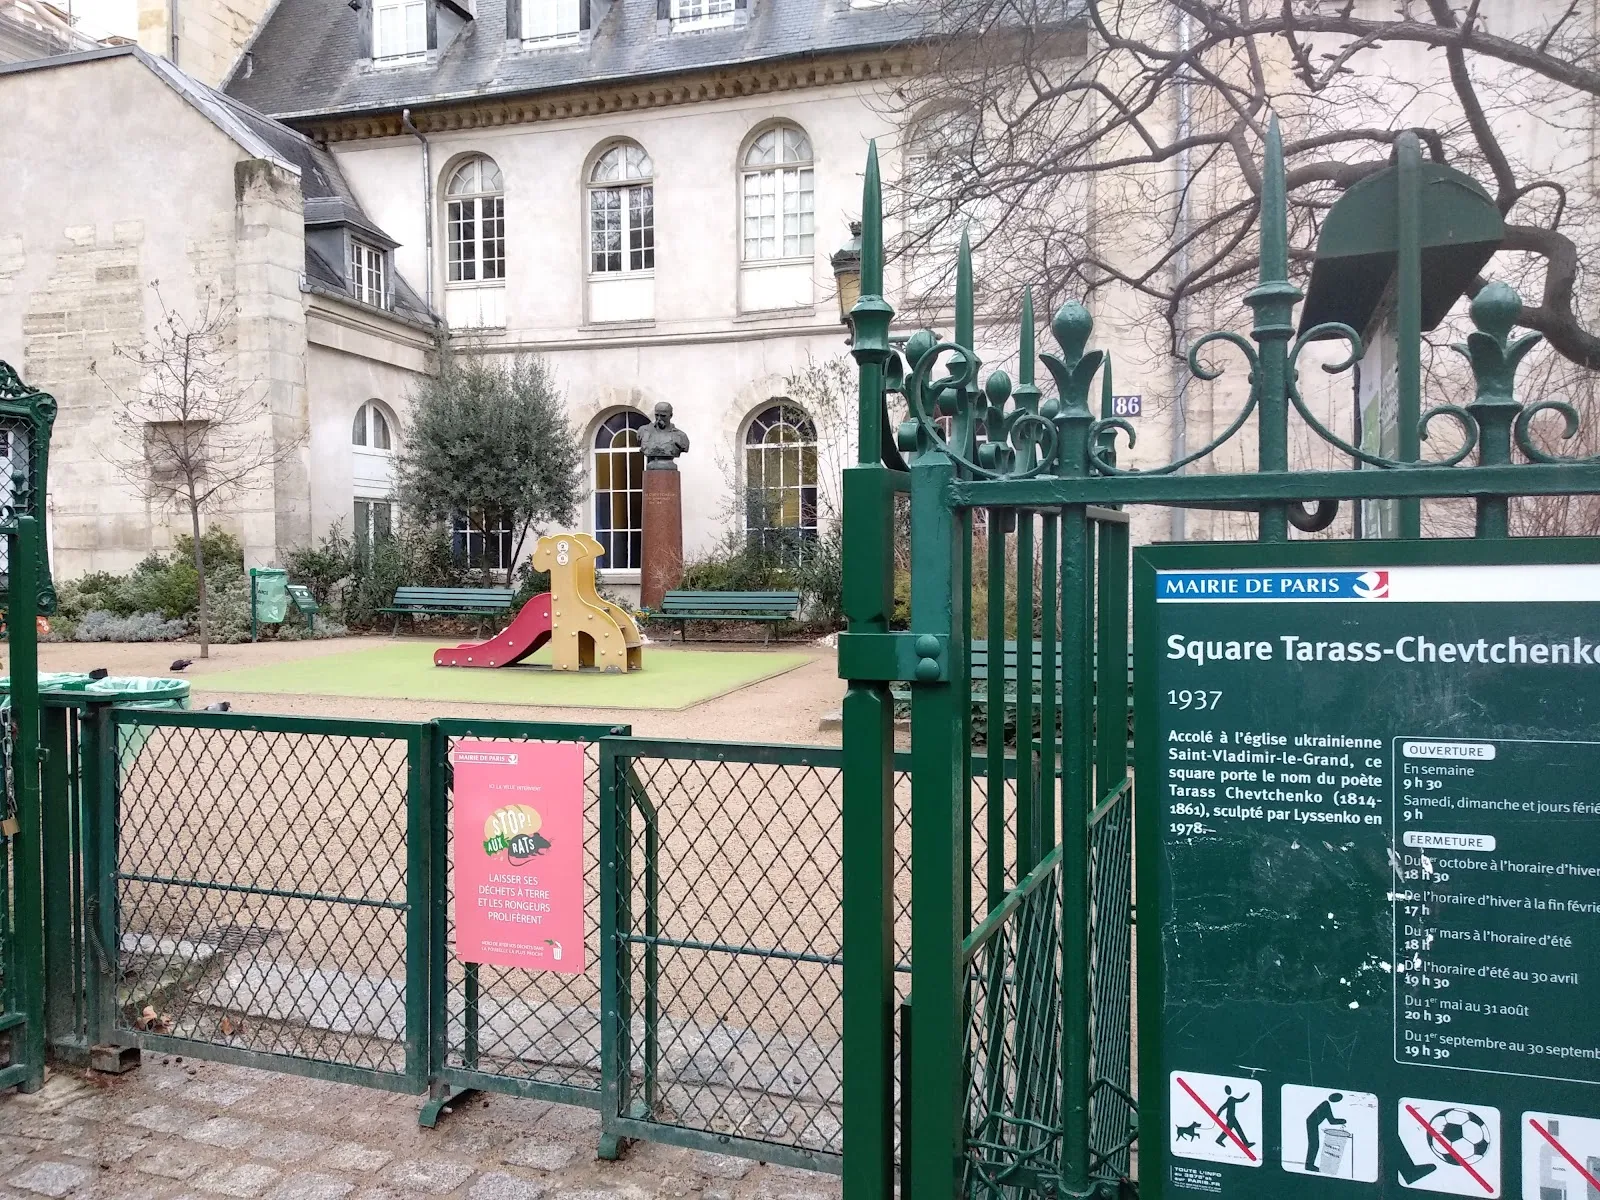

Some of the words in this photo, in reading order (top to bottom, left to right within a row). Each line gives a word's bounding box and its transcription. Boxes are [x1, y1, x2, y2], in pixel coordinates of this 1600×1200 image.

[1166, 579, 1238, 594] MAIRIE
[1246, 579, 1272, 593] DE
[1281, 578, 1339, 592] PARIS
[1167, 634, 1272, 666] Square
[1168, 689, 1222, 711] 1937
[1169, 730, 1213, 743] Accolé
[1220, 731, 1228, 744] à
[1295, 734, 1382, 749] ukrainienne
[1410, 745, 1484, 756] OUVERTURE
[1169, 748, 1355, 769] Saint-Vladimir-le-Grand,
[1365, 757, 1382, 767] ce
[1404, 764, 1418, 773] En
[1422, 765, 1474, 776] semaine
[1169, 768, 1215, 780] square
[1221, 770, 1257, 783] porte
[1262, 770, 1275, 782] le
[1281, 774, 1311, 784] nom
[1317, 772, 1335, 785] du
[1341, 774, 1382, 788] poète
[1403, 779, 1411, 789] 9
[1415, 777, 1422, 787] h
[1426, 780, 1442, 790] 30
[1169, 785, 1215, 798] Tarass
[1226, 787, 1322, 803] Chevtchenko
[1334, 791, 1382, 808] (1814-
[1404, 795, 1454, 809] Samedi,
[1457, 797, 1519, 810] dimanche
[1522, 800, 1534, 811] et
[1536, 800, 1570, 813] jours
[1170, 803, 1209, 818] 1861),
[1214, 806, 1263, 821] sculpté
[1267, 811, 1290, 822] par
[1294, 809, 1360, 824] Lyssenko
[1364, 815, 1381, 824] en
[1403, 810, 1411, 821] 9
[1415, 809, 1423, 819] h
[488, 837, 503, 852] AUX
[512, 837, 535, 854] RATS
[1410, 835, 1483, 847] FERMETURE
[1405, 855, 1421, 867] Du
[1439, 858, 1487, 870] octobre
[1490, 860, 1497, 871] à
[489, 874, 522, 885] LAISSER
[523, 875, 538, 885] SES
[1405, 869, 1418, 880] 18
[1422, 869, 1430, 881] h
[1433, 873, 1449, 883] 30
[479, 884, 515, 897] DÉCHETS
[517, 886, 523, 897] À
[524, 889, 549, 899] TERRE
[478, 898, 488, 907] ET
[489, 899, 503, 908] LES
[505, 900, 550, 912] RONGEURS
[1405, 890, 1420, 901] De
[1524, 896, 1531, 909] à
[1534, 898, 1545, 909] la
[1548, 899, 1564, 910] fin
[1405, 906, 1418, 916] 17
[1422, 905, 1430, 915] h
[488, 912, 542, 924] PROLIFÈRENT
[1405, 925, 1421, 936] Du
[1440, 930, 1470, 941] mars
[1473, 931, 1480, 941] à
[1405, 940, 1419, 950] 18
[1422, 940, 1430, 950] h
[1405, 976, 1419, 987] 19
[1422, 975, 1430, 986] h
[1433, 978, 1449, 989] 30
[1513, 971, 1528, 981] au
[1532, 972, 1547, 983] 30
[1550, 972, 1578, 984] avril
[1405, 995, 1421, 1007] Du
[1440, 999, 1462, 1011] mai
[1465, 1002, 1480, 1012] au
[1484, 1005, 1497, 1016] 31
[1500, 1004, 1529, 1016] août
[1405, 1011, 1421, 1020] 20
[1424, 1010, 1431, 1021] h
[1435, 1013, 1451, 1024] 30
[1405, 1030, 1421, 1042] Du
[1439, 1034, 1506, 1050] septembre
[1509, 1041, 1524, 1052] au
[1527, 1044, 1543, 1055] 30
[1405, 1045, 1419, 1057] 19
[1422, 1045, 1430, 1056] h
[1434, 1048, 1450, 1059] 30
[1188, 1178, 1220, 1187] PARIS.FR
